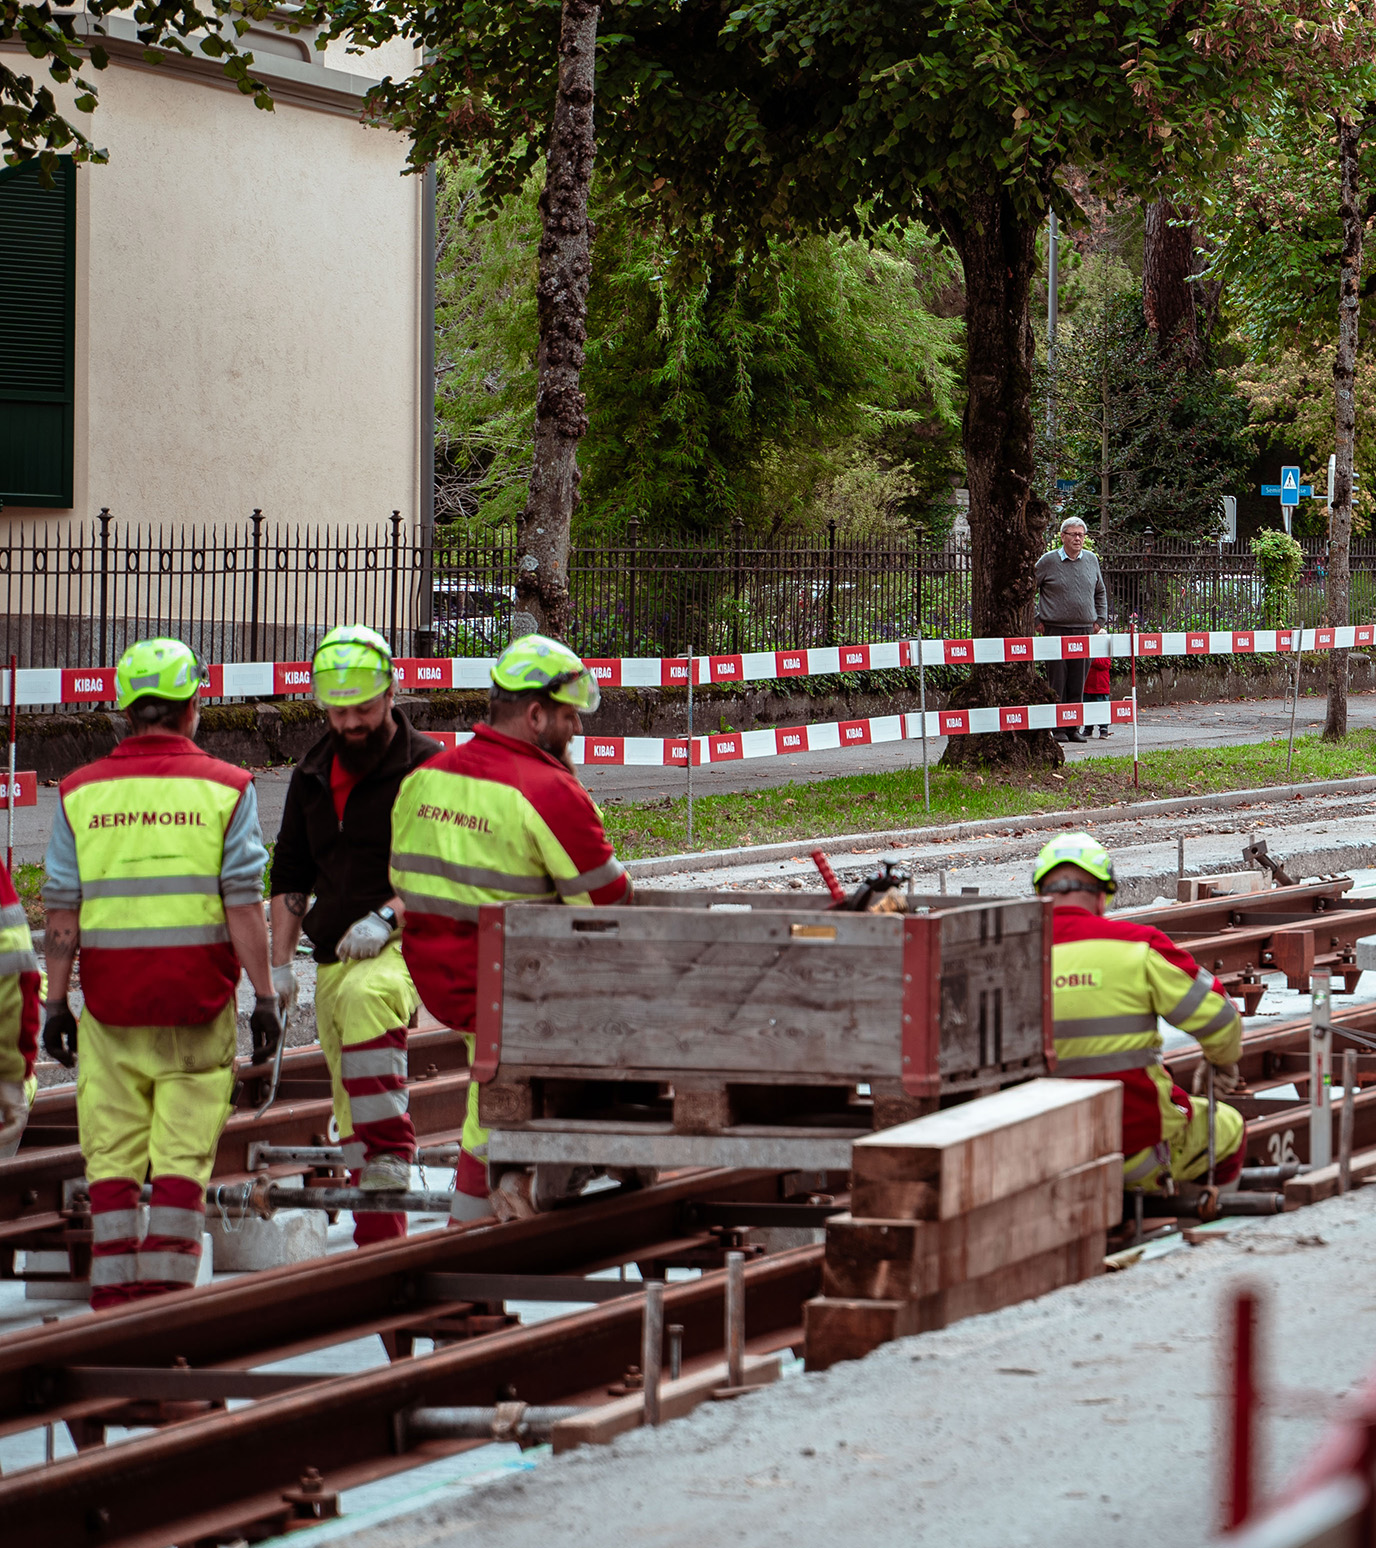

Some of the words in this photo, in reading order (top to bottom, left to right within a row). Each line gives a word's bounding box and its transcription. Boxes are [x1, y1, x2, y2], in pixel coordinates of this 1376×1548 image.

[1068, 642, 1083, 652] KIBAG
[1144, 640, 1157, 649] KIBAG
[1191, 638, 1204, 648] KIBAG
[1237, 637, 1250, 647] KIBAG
[951, 646, 967, 657] KIBAG
[1011, 644, 1027, 655] KIBAG
[783, 658, 800, 669] KIBAG
[846, 653, 862, 664] KIBAG
[417, 668, 441, 680] KIBAG
[591, 667, 612, 678] KIBAG
[717, 663, 735, 675] KIBAG
[285, 671, 310, 684] KIBAG
[75, 678, 103, 692] KIBAG
[1062, 710, 1077, 720] KIBAG
[1117, 707, 1131, 717] KIBAG
[946, 717, 962, 727] KIBAG
[1006, 713, 1022, 723] KIBAG
[846, 728, 863, 739] KIBAG
[783, 735, 800, 746] KIBAG
[594, 745, 615, 757] KIBAG
[672, 747, 688, 758] KIBA
[717, 742, 735, 754] KIBAG
